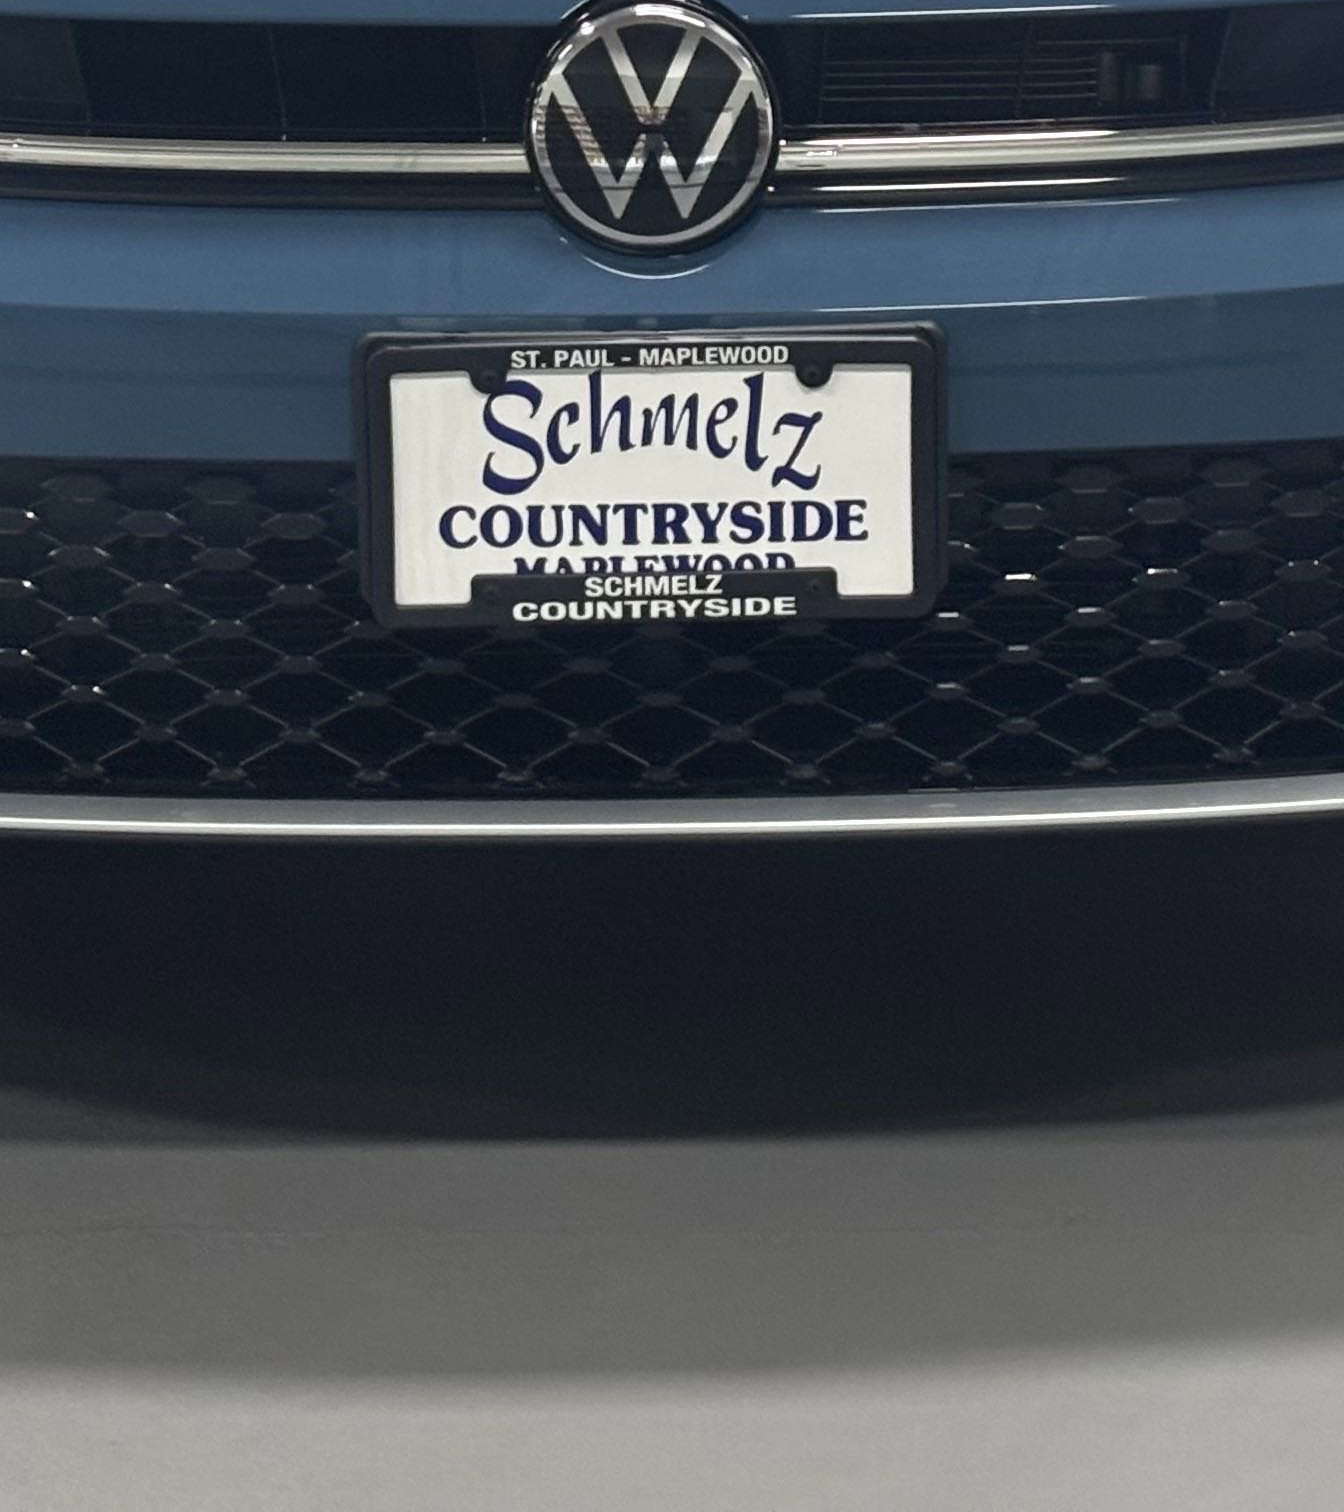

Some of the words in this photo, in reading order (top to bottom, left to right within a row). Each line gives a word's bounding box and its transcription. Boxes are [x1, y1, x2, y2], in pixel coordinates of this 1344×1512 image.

[511, 350, 546, 369] ST.
[554, 349, 614, 367] PAUL
[639, 345, 789, 366] MAPLEWOOD
[482, 369, 823, 495] Schmelz
[439, 499, 868, 548] COUNTRYSIDE
[584, 574, 724, 598] SCHMELZ
[512, 596, 797, 622] COUNTRYSIDE
